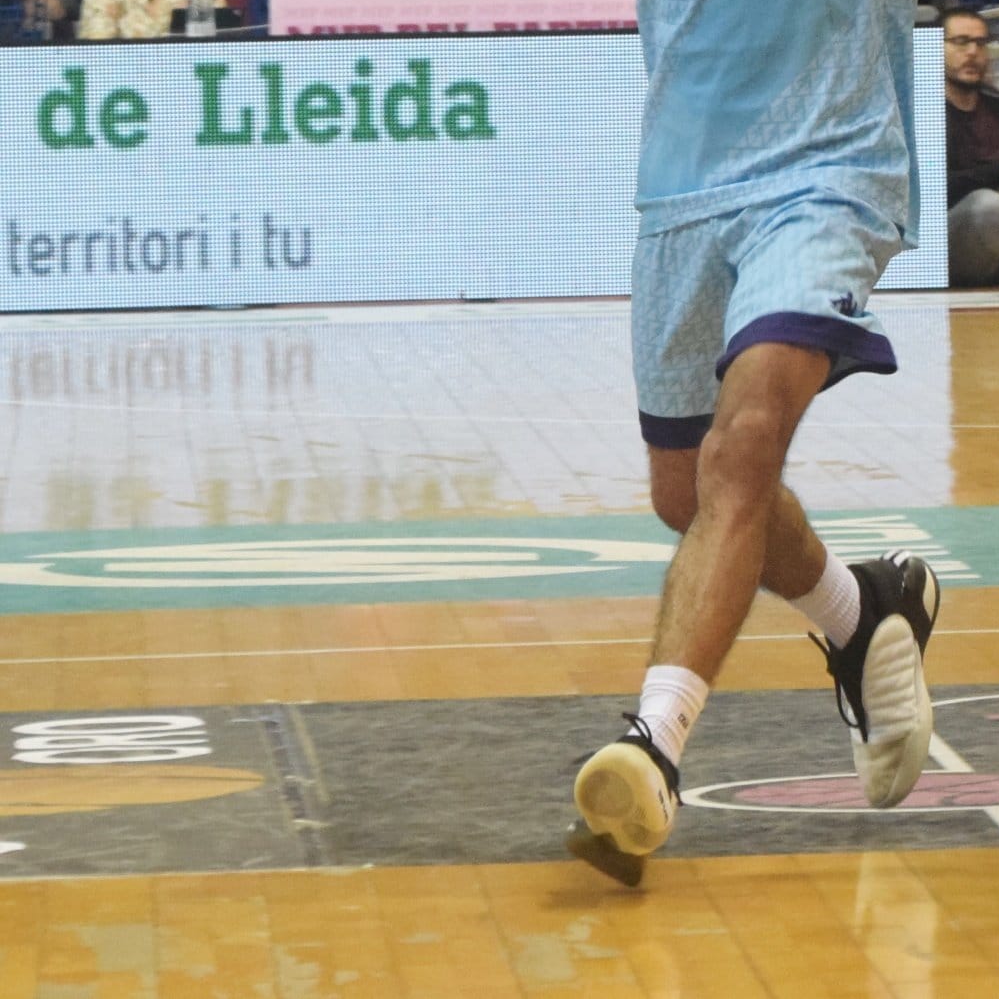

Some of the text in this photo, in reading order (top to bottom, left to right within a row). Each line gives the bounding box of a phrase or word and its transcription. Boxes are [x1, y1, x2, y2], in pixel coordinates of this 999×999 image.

[37, 57, 497, 151] de Lleida
[7, 213, 312, 277] territori i tu
